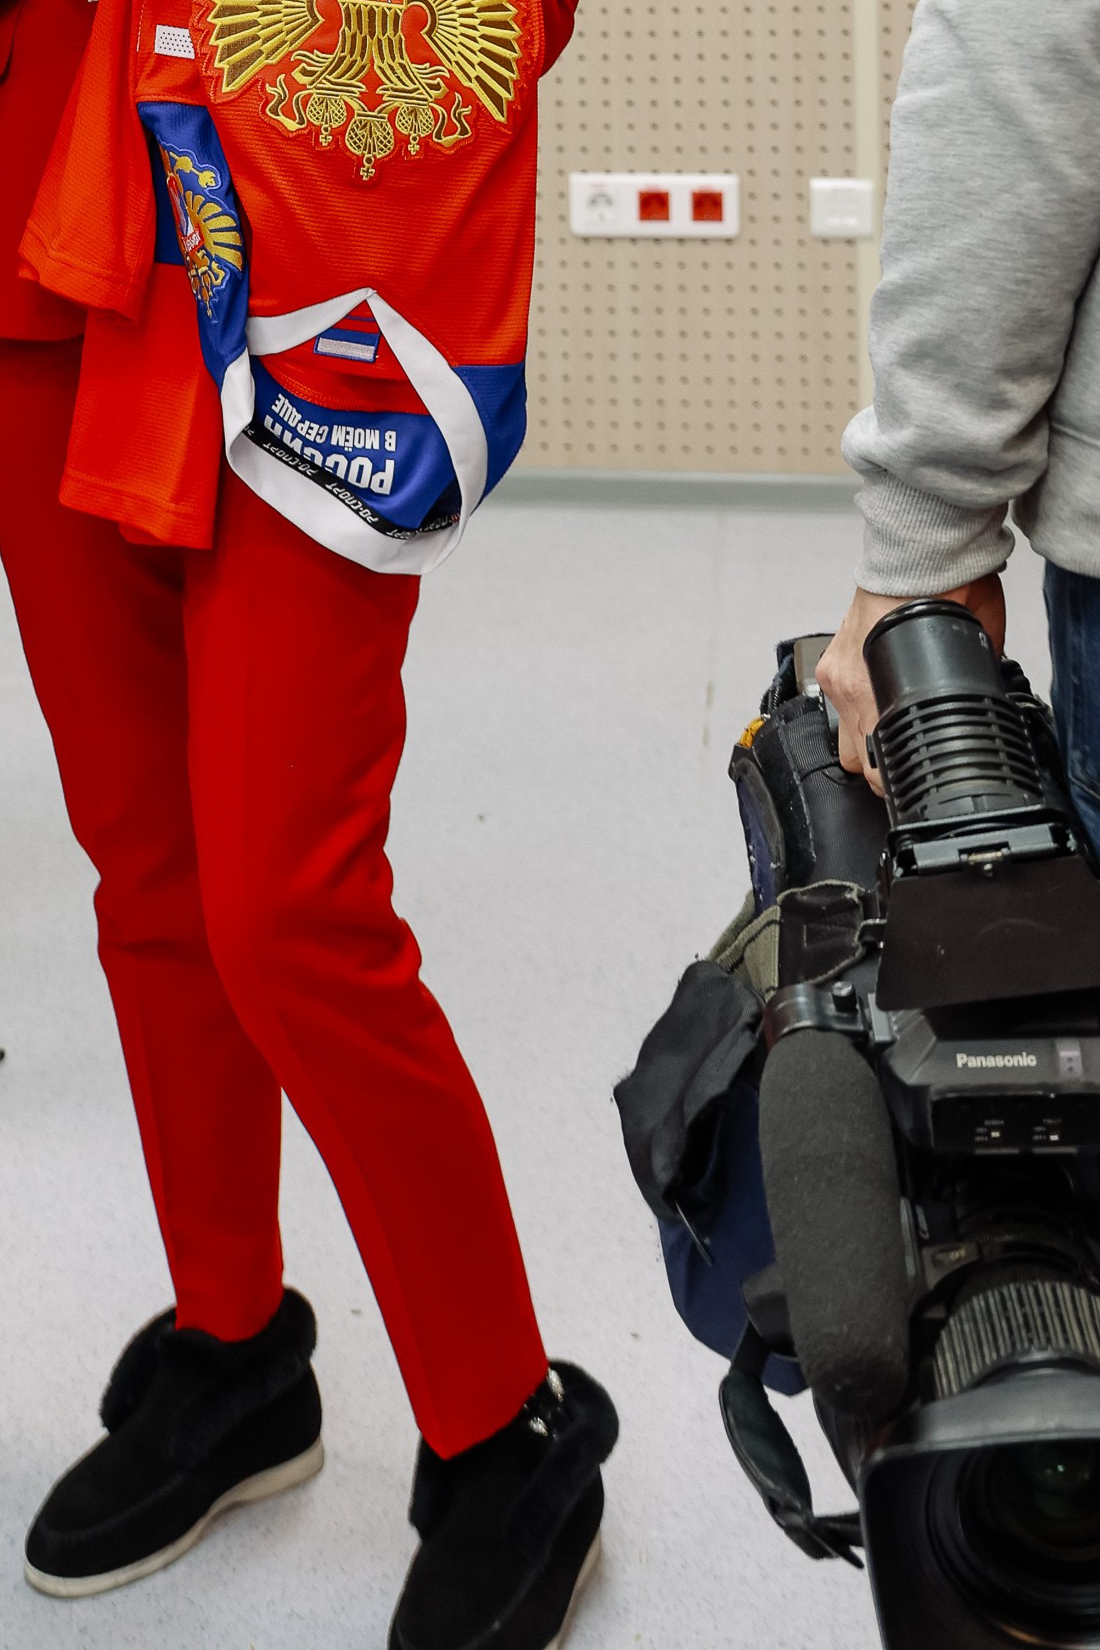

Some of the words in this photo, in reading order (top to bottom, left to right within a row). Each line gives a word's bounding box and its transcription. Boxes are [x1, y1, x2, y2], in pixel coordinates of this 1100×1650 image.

[271, 393, 329, 444] СЕРДЦЕ
[330, 424, 380, 453] МОЁМ
[384, 430, 397, 452] В
[956, 1051, 1038, 1068] Panasonic
